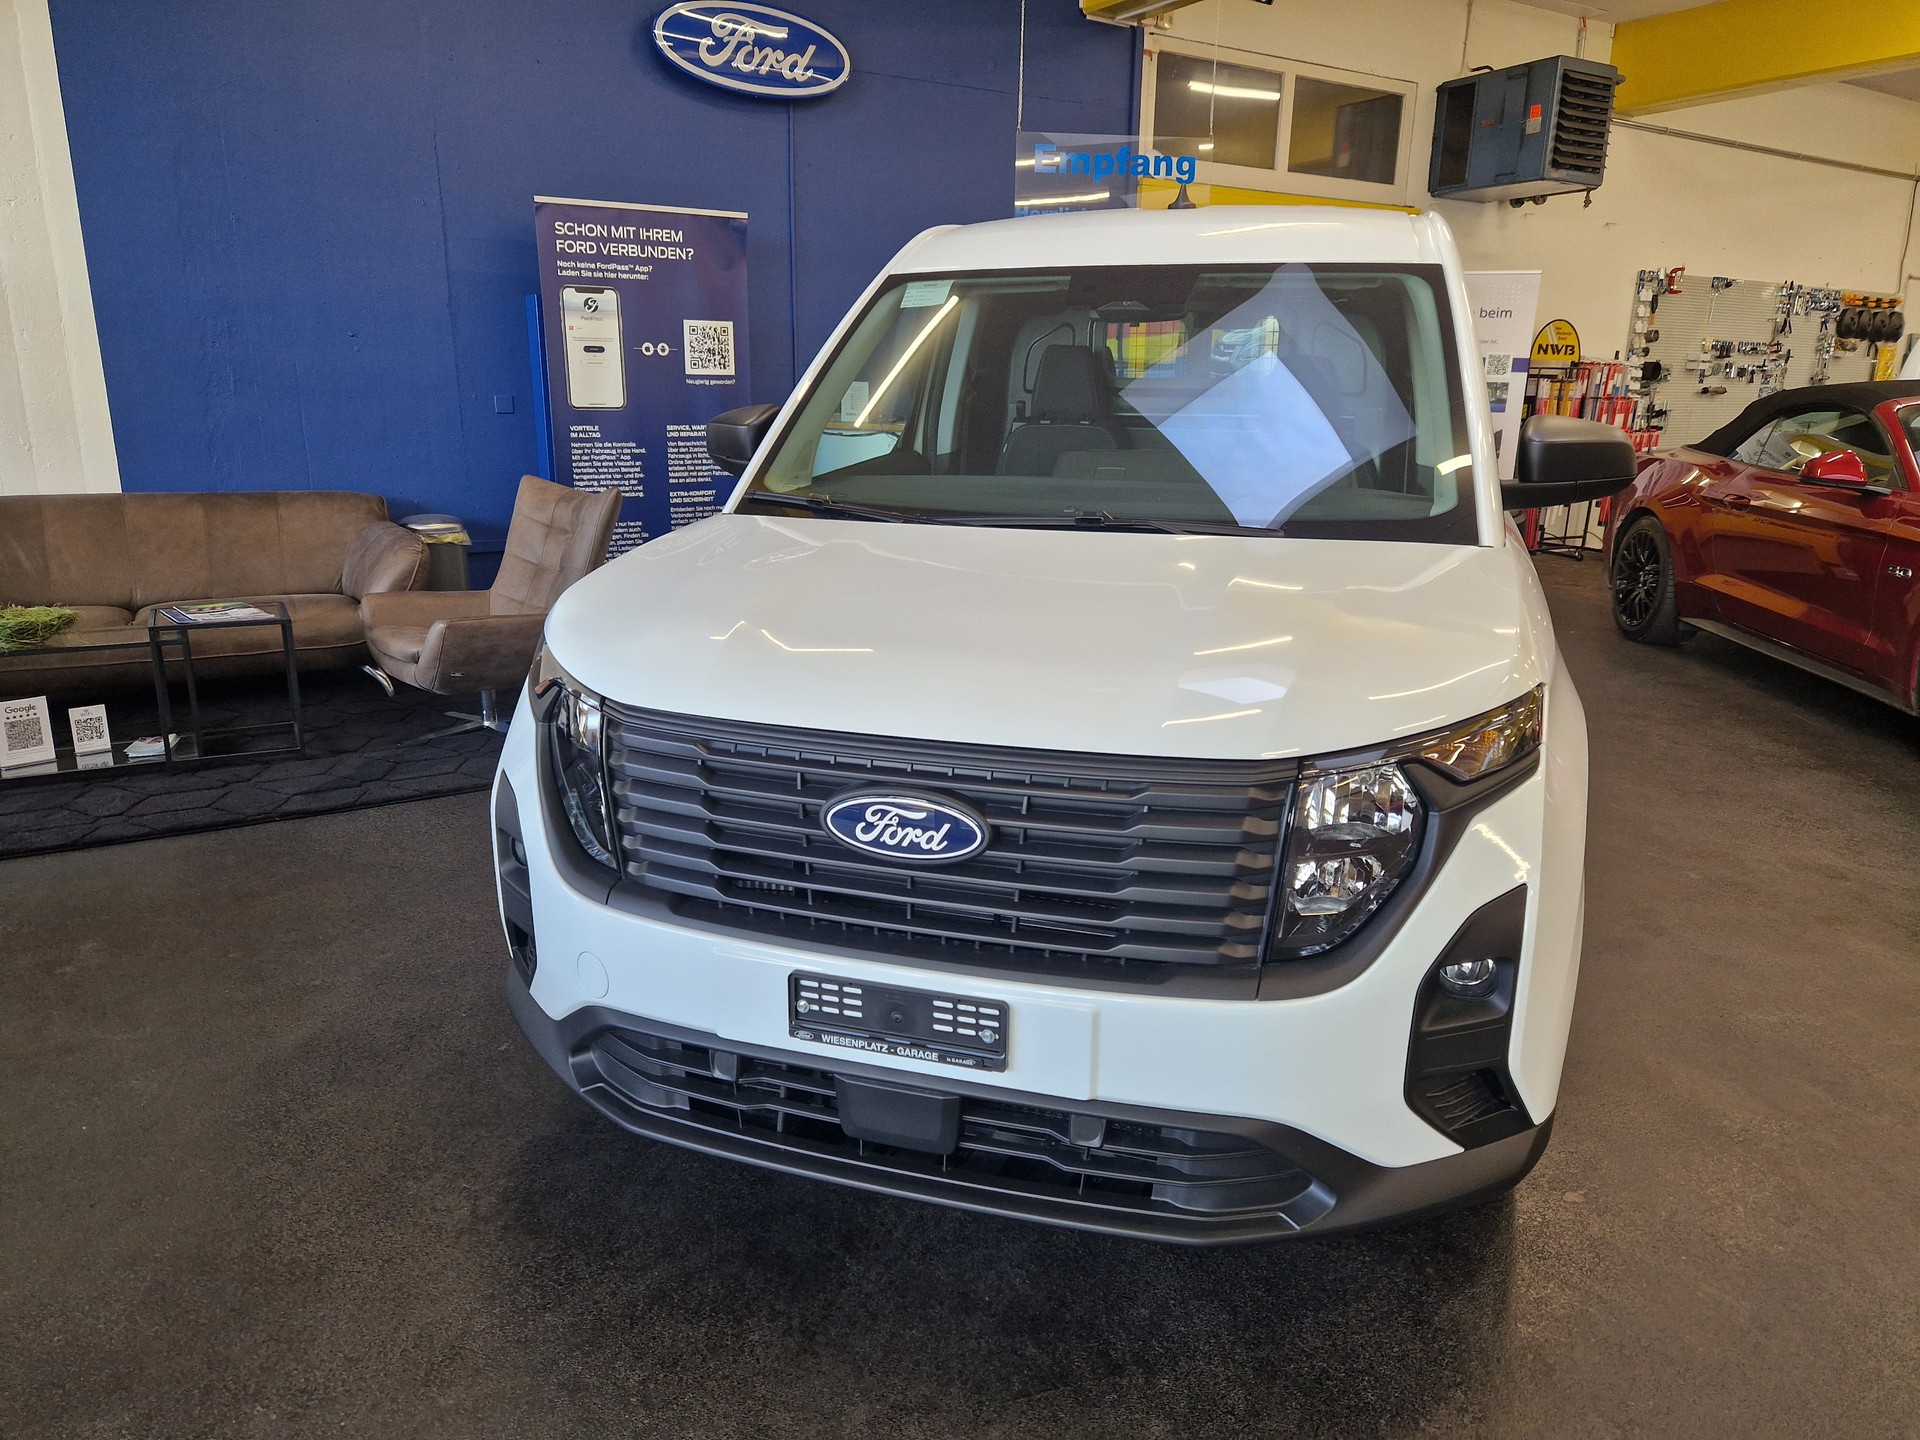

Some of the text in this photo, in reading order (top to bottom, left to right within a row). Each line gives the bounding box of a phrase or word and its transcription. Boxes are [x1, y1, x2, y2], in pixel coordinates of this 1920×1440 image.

[699, 13, 817, 82] Ford
[1034, 143, 1197, 185] Empfang
[554, 221, 683, 242] SCHON MIT IHREM
[556, 240, 694, 260] FORD VERBUNDEN?
[557, 260, 576, 268] Noch
[576, 261, 596, 269] keine
[635, 264, 653, 273] App?
[557, 269, 580, 277] Laden
[604, 271, 617, 279] hier
[618, 272, 649, 280] herunter:
[1480, 307, 1513, 318] beim
[1537, 343, 1576, 355] NWB
[5, 703, 37, 714] Google
[855, 804, 951, 851] Ford
[821, 1033, 889, 1053] WIESENPLATZ
[896, 1046, 939, 1062] GARAGE
